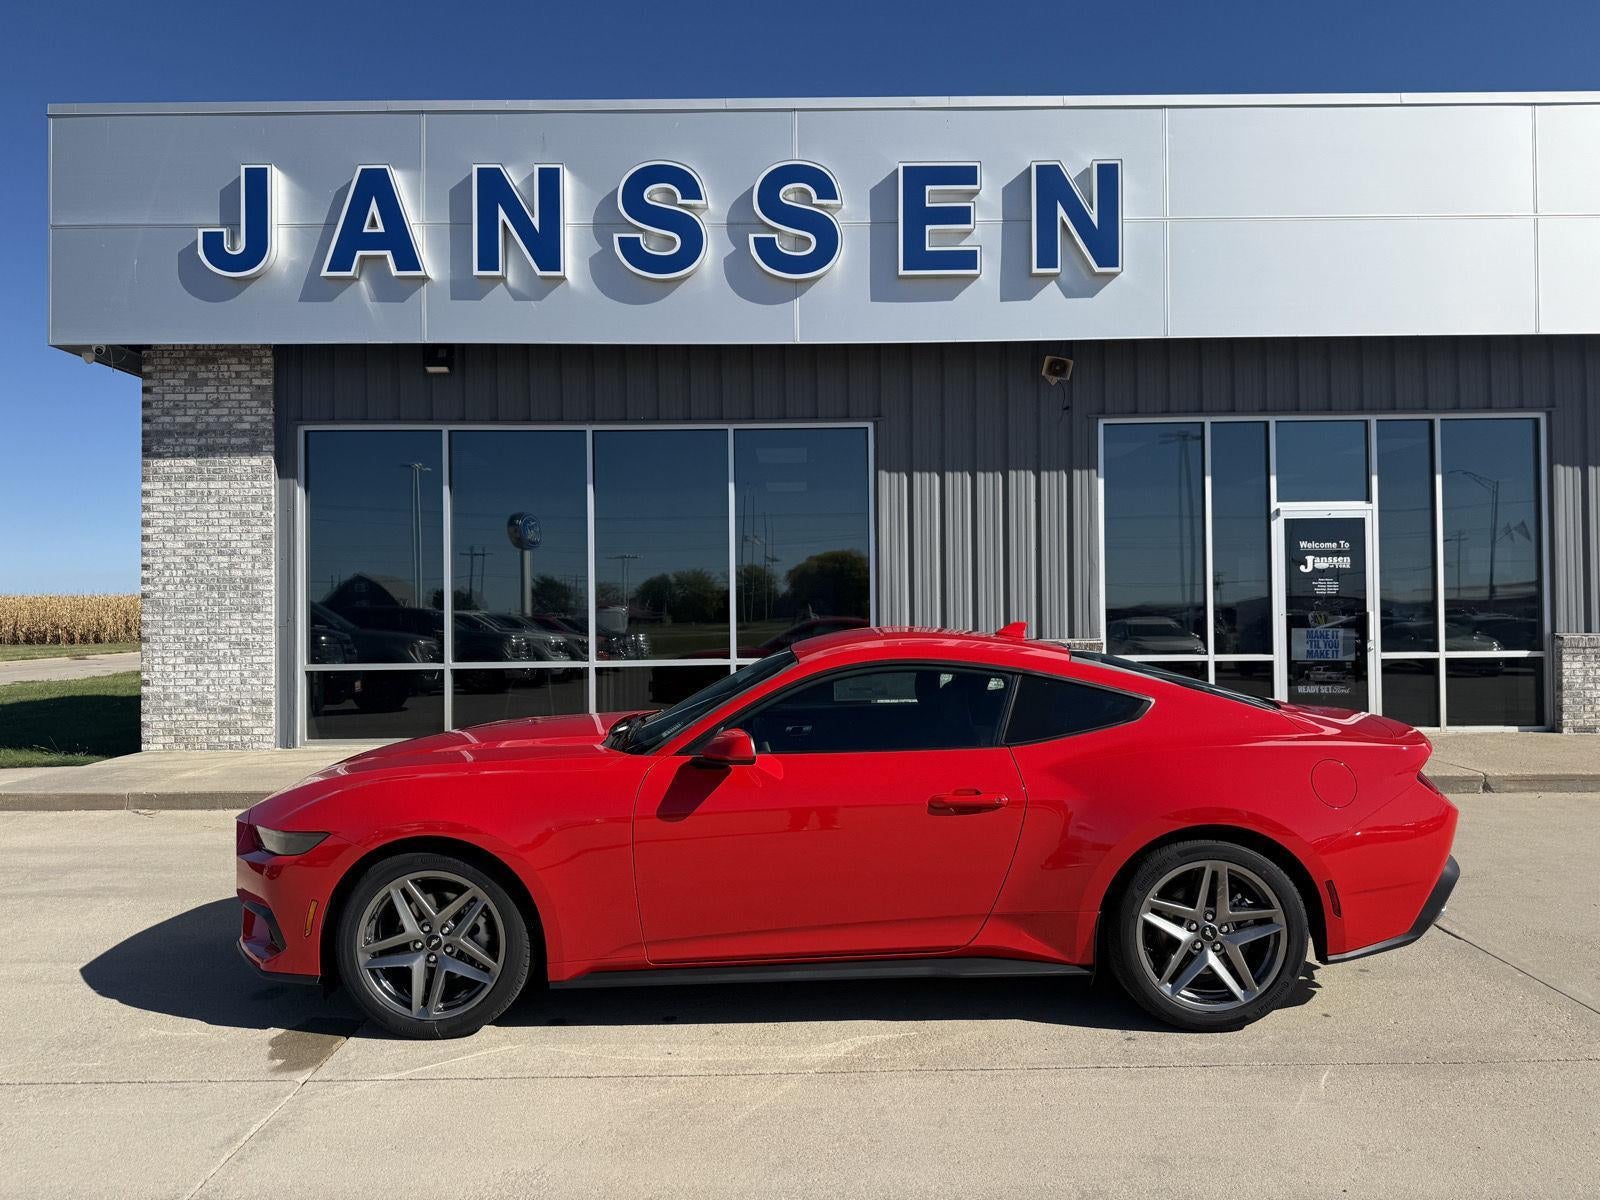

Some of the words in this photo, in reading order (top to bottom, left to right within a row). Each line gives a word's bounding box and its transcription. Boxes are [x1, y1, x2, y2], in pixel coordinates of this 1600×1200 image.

[198, 158, 1123, 281] JANSSEN
[1299, 541, 1337, 549] Welcome
[1339, 541, 1350, 549] To
[1299, 555, 1351, 573] Janssen
[1306, 630, 1331, 640] MAKE
[1332, 630, 1340, 640] IT
[1323, 640, 1340, 649] YOU
[1306, 649, 1331, 659] MAKE
[1332, 649, 1340, 659] IT
[1297, 685, 1319, 694] READY
[1320, 685, 1332, 694] SET
